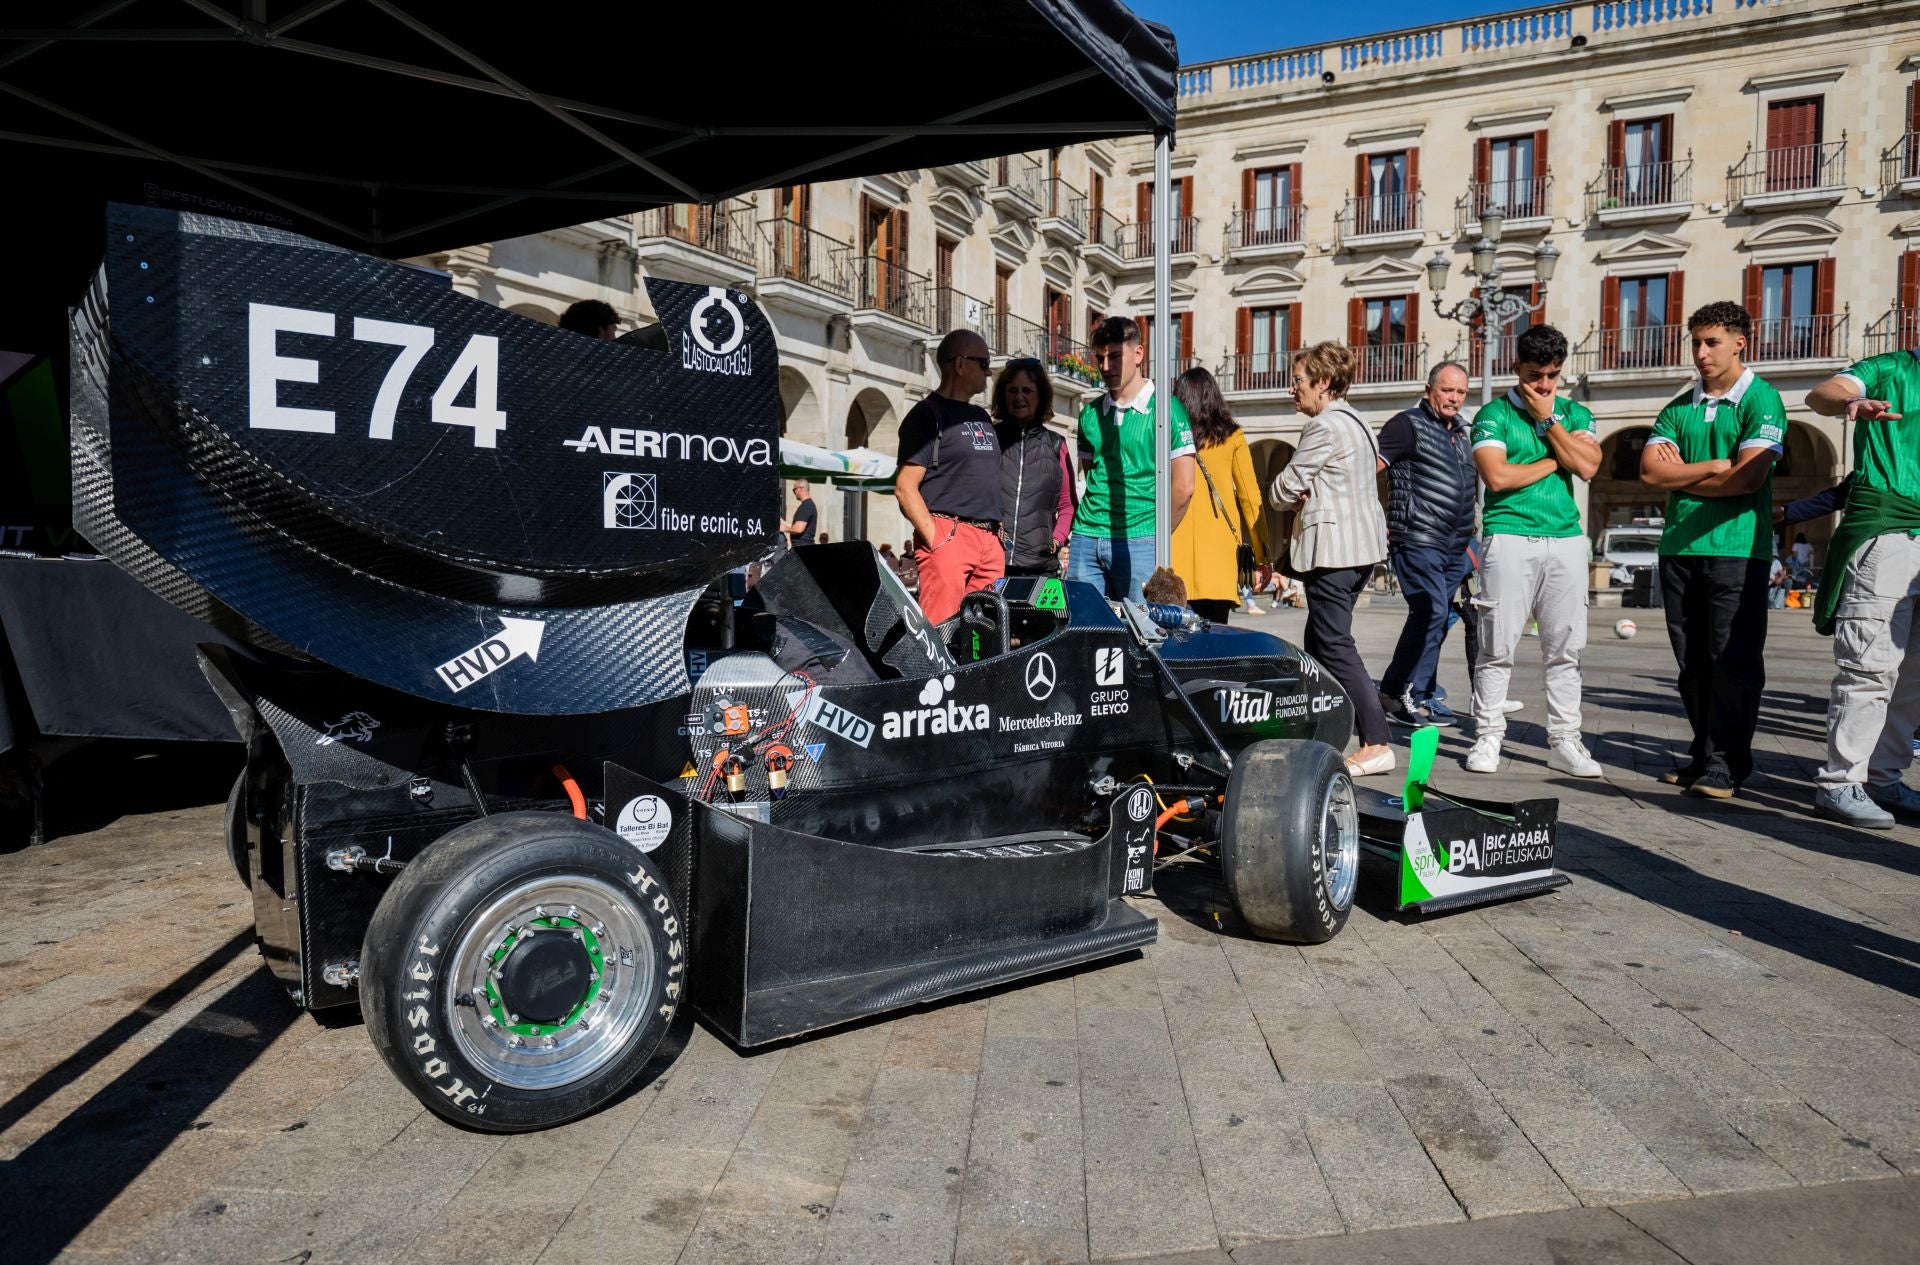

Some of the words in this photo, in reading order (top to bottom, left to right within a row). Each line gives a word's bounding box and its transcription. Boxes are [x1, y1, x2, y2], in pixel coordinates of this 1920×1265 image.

[682, 331, 740, 376] ELASTOCAUCHO
[248, 302, 507, 449] E74
[661, 507, 695, 532] fiber
[700, 512, 743, 538] ecnic,
[440, 639, 511, 689] HVD
[1090, 689, 1129, 703] GRUPO
[1213, 688, 1273, 725] Vital
[882, 700, 990, 740] arratxa
[1090, 703, 1129, 716] ELEYCO
[1275, 705, 1308, 719] FUNDAZIOA
[677, 726, 705, 736] GND
[814, 701, 869, 743] HVD
[998, 711, 1083, 733] Mercedes-Benz
[698, 749, 712, 758] TS
[1040, 740, 1065, 750] VITORIA
[620, 824, 647, 833] Talleres
[1486, 834, 1507, 850] BIC
[1508, 829, 1549, 849] ARABA
[1449, 838, 1481, 873] BA
[1485, 851, 1503, 867] UP!
[1505, 845, 1554, 865] EUSKADI
[1128, 868, 1141, 880] KON
[627, 864, 683, 1023] Hoosier
[403, 934, 479, 1107] Hoosier
